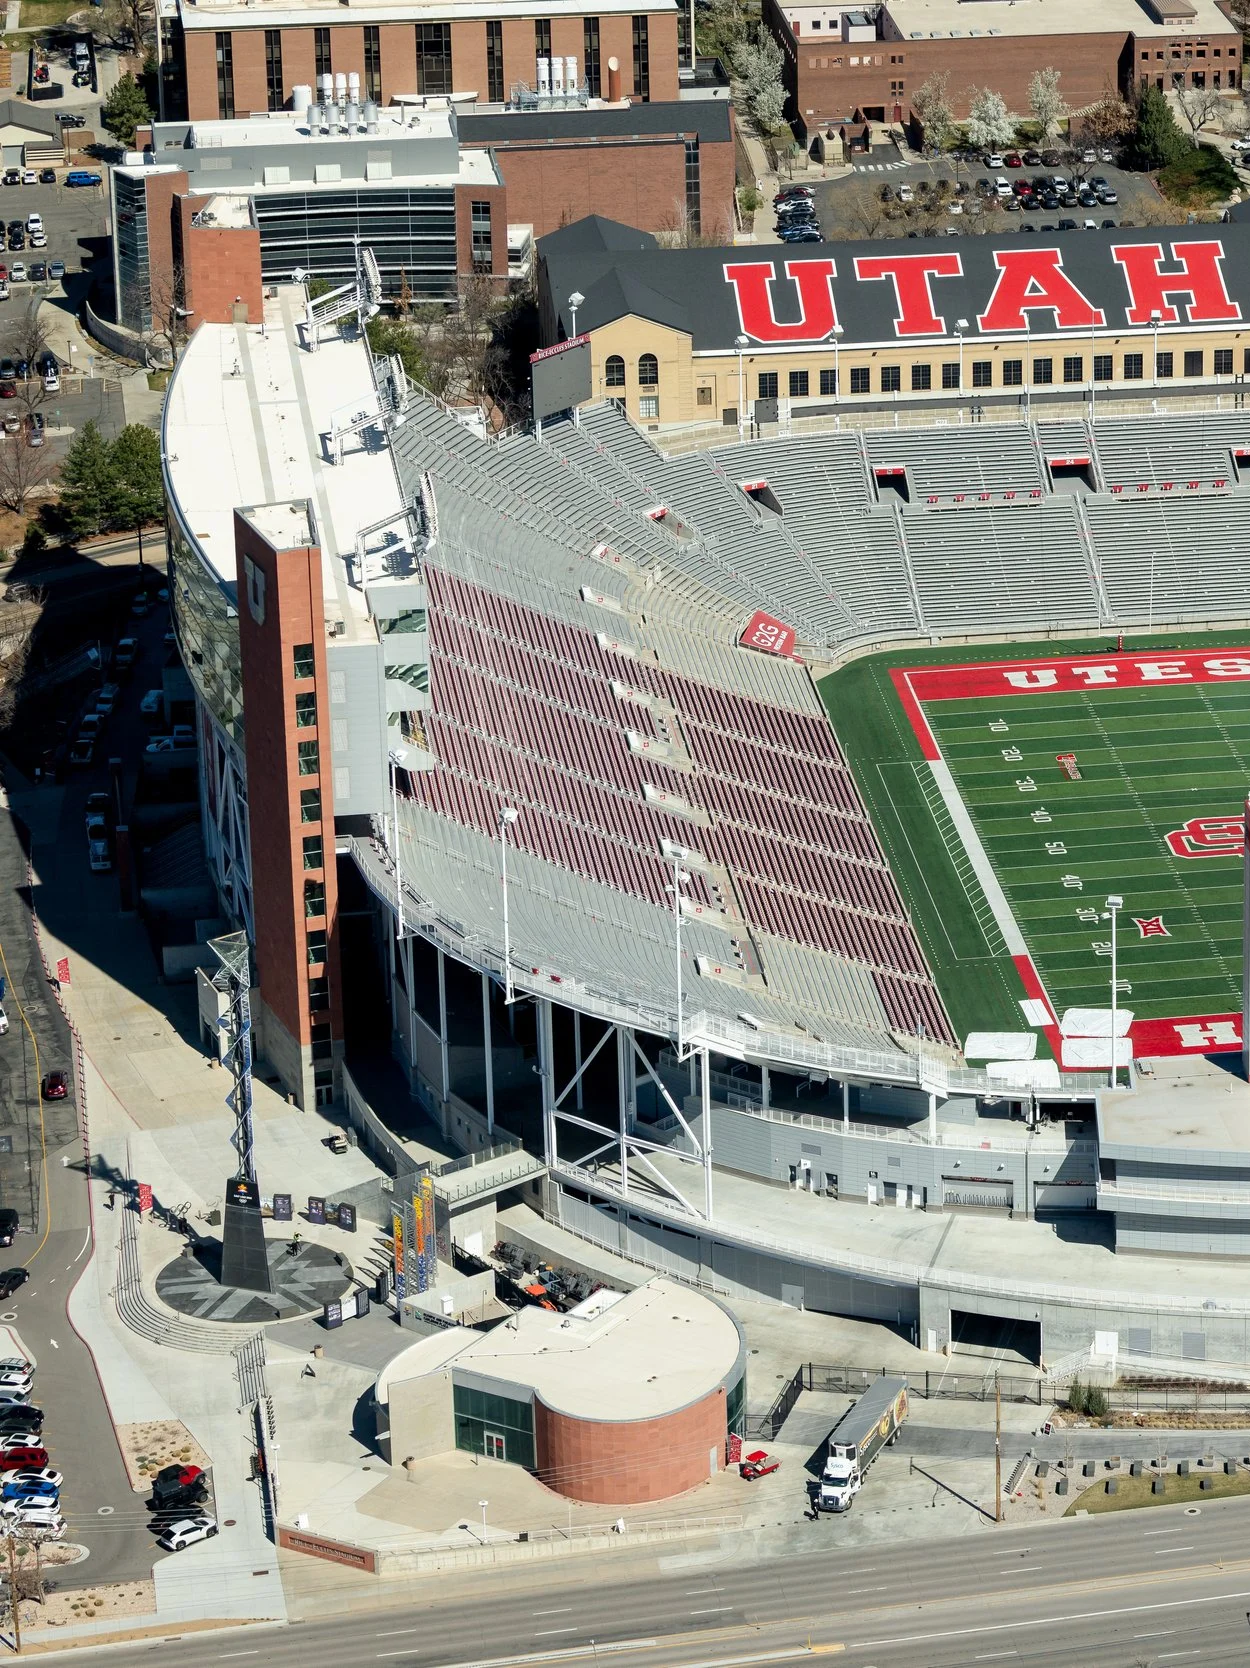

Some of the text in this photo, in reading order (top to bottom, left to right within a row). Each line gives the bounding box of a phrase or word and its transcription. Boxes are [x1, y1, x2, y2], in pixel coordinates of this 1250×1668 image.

[723, 239, 1242, 344] UTAH
[244, 552, 266, 626] U
[751, 622, 779, 647] G2G
[988, 721, 1010, 732] 10
[1001, 748, 1024, 761] 20
[1015, 778, 1038, 792] 30
[1030, 810, 1053, 823] 40
[1045, 841, 1068, 855] 50
[1060, 874, 1083, 888] 40
[1075, 907, 1099, 921] 30
[1091, 941, 1113, 956] 20
[830, 1461, 844, 1470] Sysco
